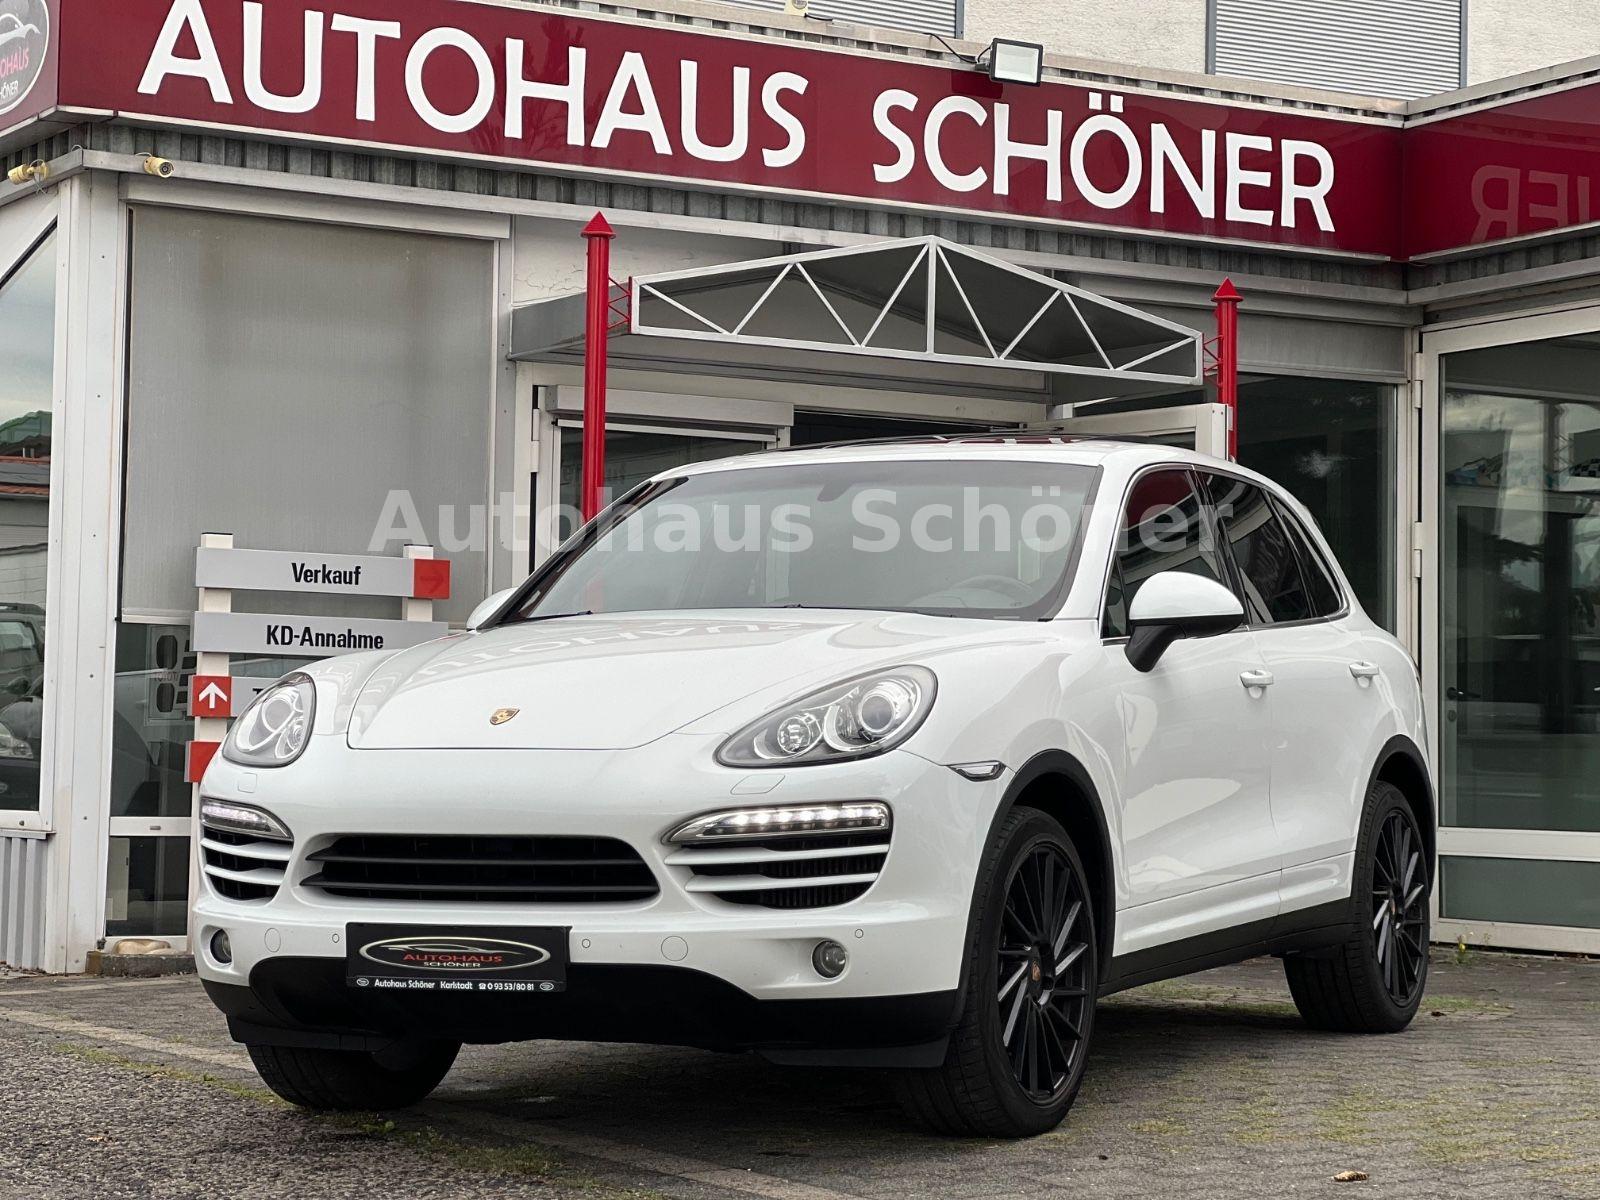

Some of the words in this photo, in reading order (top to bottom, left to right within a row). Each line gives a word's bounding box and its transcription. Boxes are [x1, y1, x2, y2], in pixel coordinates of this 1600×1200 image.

[137, 0, 809, 169] AUTOHAUS
[872, 92, 1336, 232] SCHÖNER
[291, 562, 361, 586] Verkauf
[266, 624, 384, 649] KD-Annahme
[403, 953, 502, 962] AUTOHAUS
[374, 978, 407, 988] Autohaus
[408, 979, 436, 989] Schöner
[440, 980, 473, 990] Karlstadt
